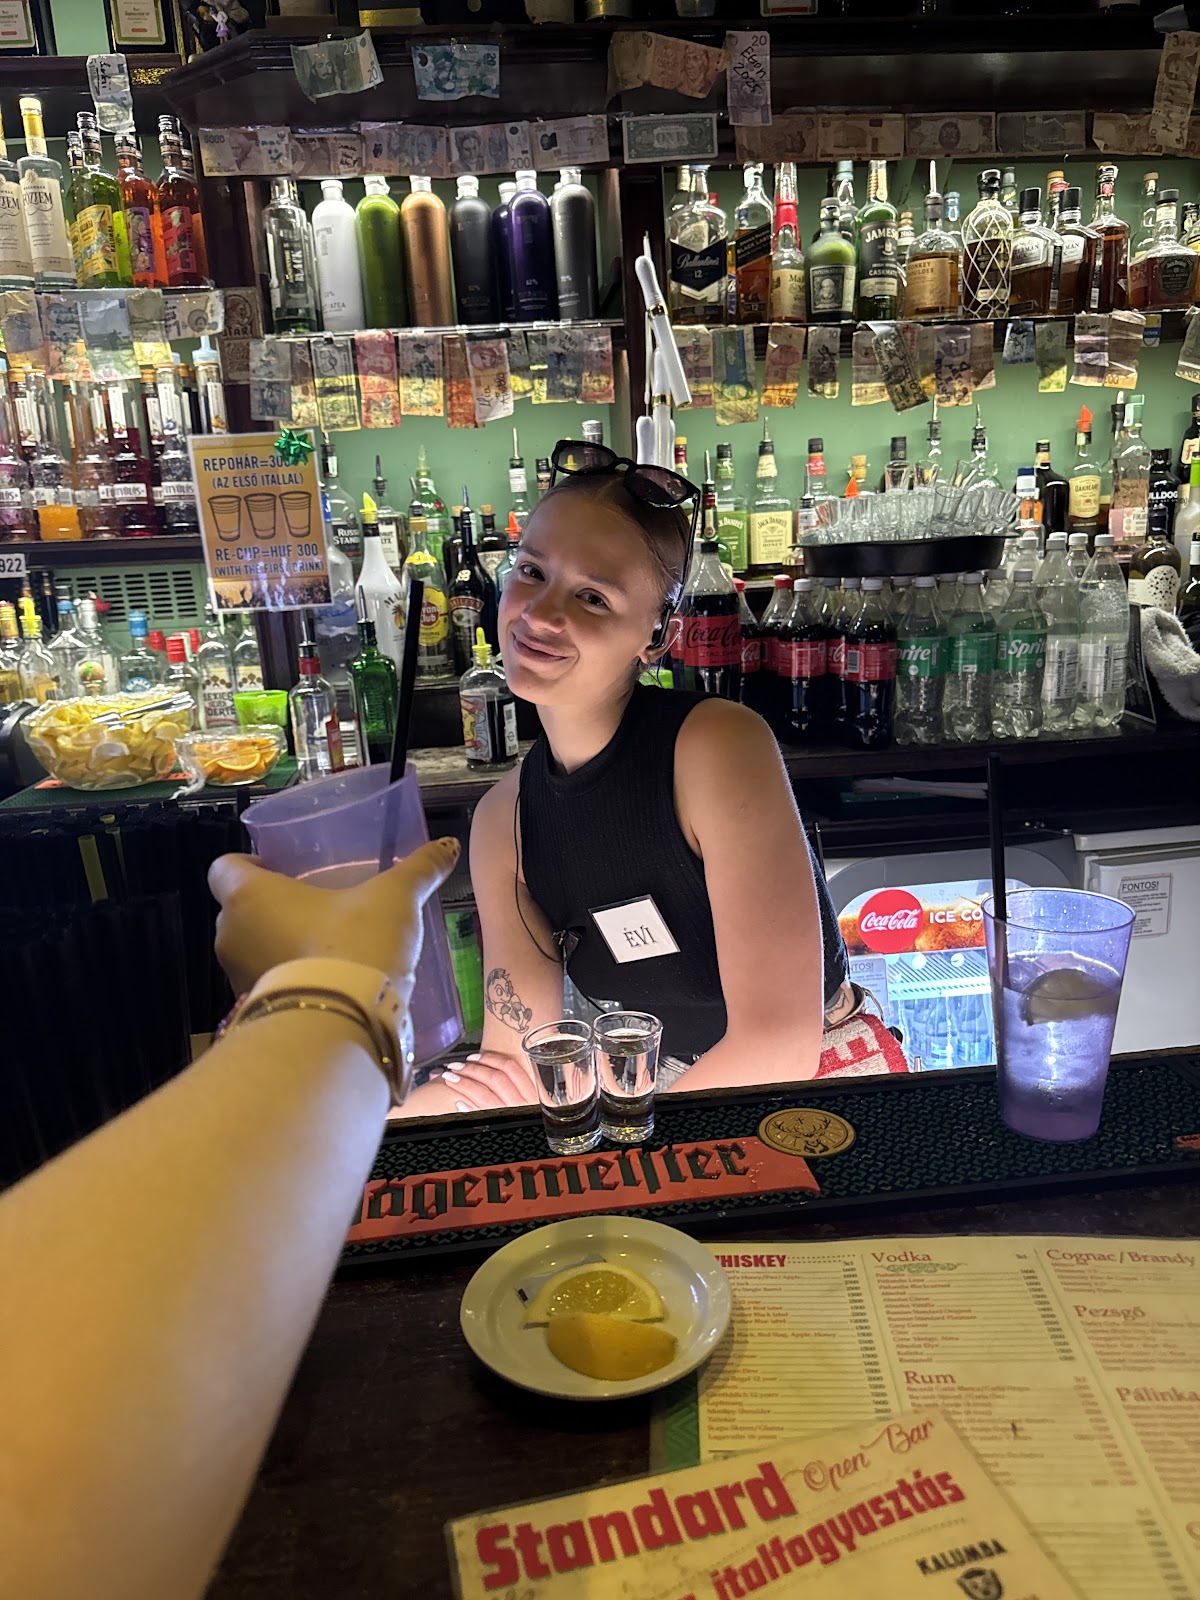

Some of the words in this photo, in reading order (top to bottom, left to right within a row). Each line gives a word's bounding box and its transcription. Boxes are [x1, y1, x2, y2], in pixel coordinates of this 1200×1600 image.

[752, 35, 767, 47] 20
[511, 158, 530, 168] 200
[694, 270, 702, 278] 12
[212, 475, 229, 490] (AZ
[261, 472, 304, 488] ITALLAL)
[1148, 490, 1178, 499] ULLDOG
[297, 543, 319, 557] 300
[214, 564, 242, 577] (WITH
[1008, 637, 1047, 657] Sprit
[1122, 880, 1159, 893] FONTOS!
[861, 908, 921, 932] Coca-Cola
[929, 910, 957, 924] ICE
[850, 962, 874, 973] NTOS!
[871, 1251, 932, 1264] Vodka
[1073, 1304, 1147, 1320] Pezsgő
[904, 1370, 956, 1384] Rum
[476, 1461, 798, 1592] Standard
[800, 1452, 871, 1493] Open
[872, 1420, 935, 1454] Bar
